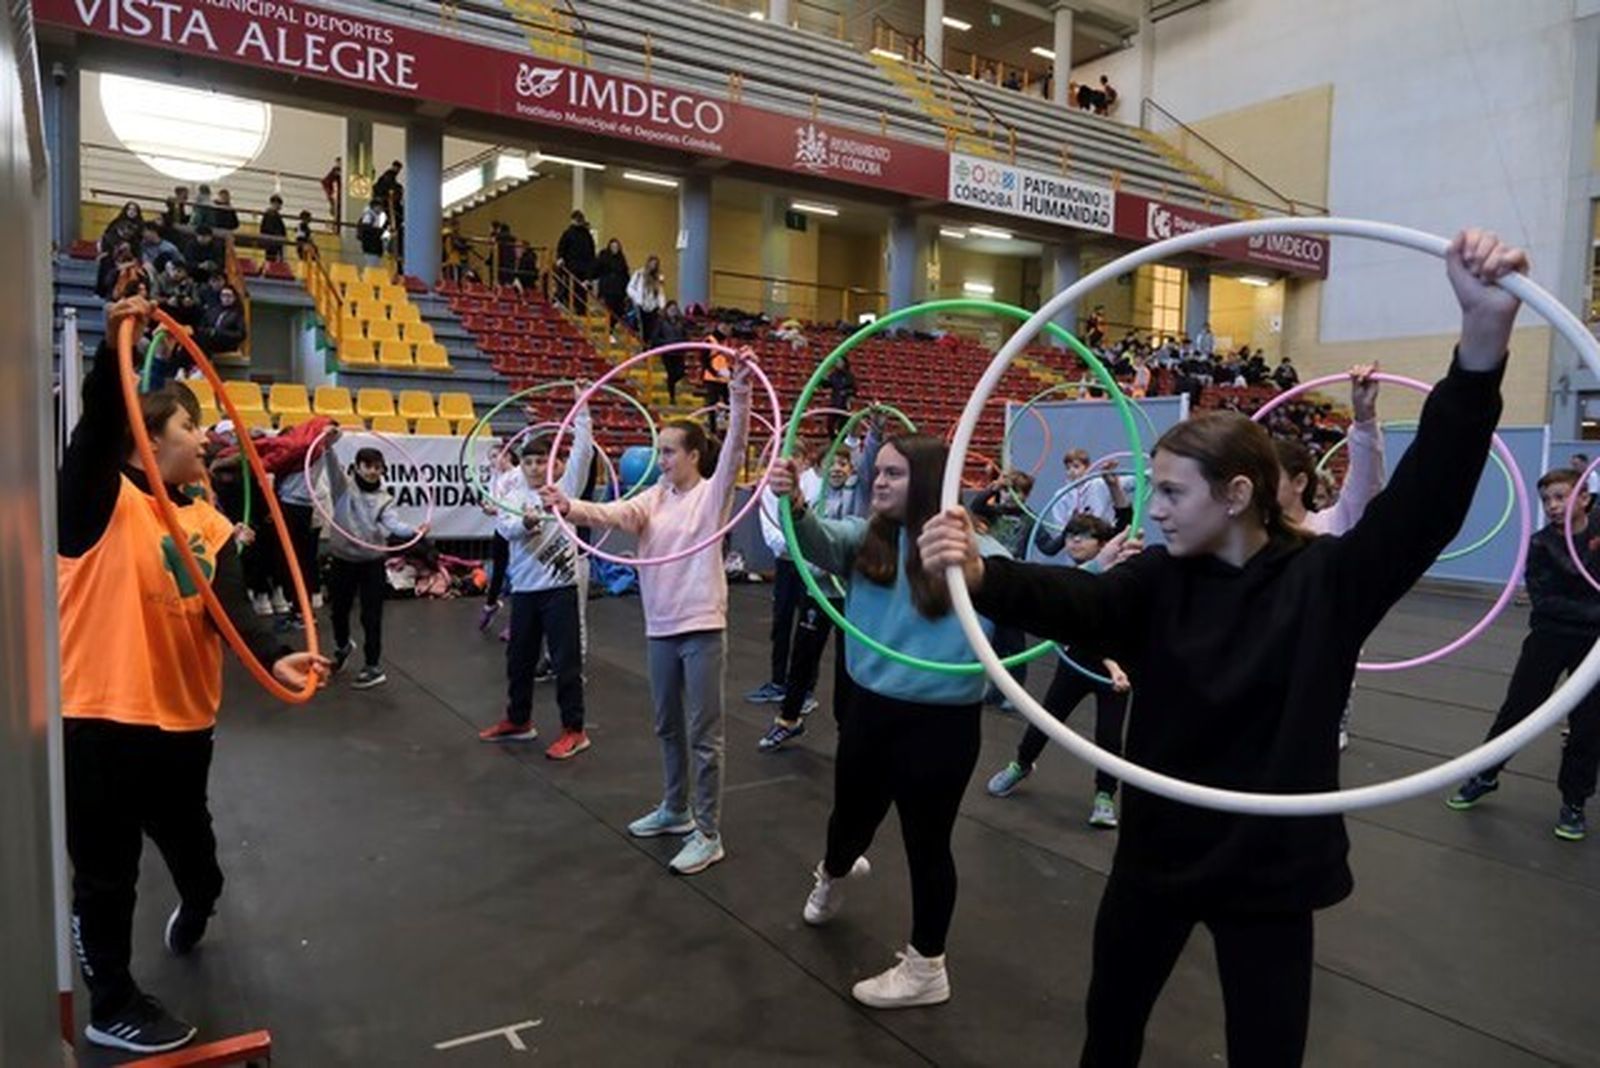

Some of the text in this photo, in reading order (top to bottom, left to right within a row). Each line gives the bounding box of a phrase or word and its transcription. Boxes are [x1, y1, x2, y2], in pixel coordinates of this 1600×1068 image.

[304, 12, 394, 45] DEPORTES
[75, 0, 418, 89] VISTA ALEGRE
[568, 71, 724, 134] IMDECO
[564, 112, 618, 132] Municipal
[634, 126, 680, 143] Deportes
[955, 183, 1013, 208] CÓRDOBA
[1024, 177, 1100, 207] PATRIMONIO
[1022, 195, 1110, 227] HUMANIDAD
[1267, 233, 1323, 261] IMDECO
